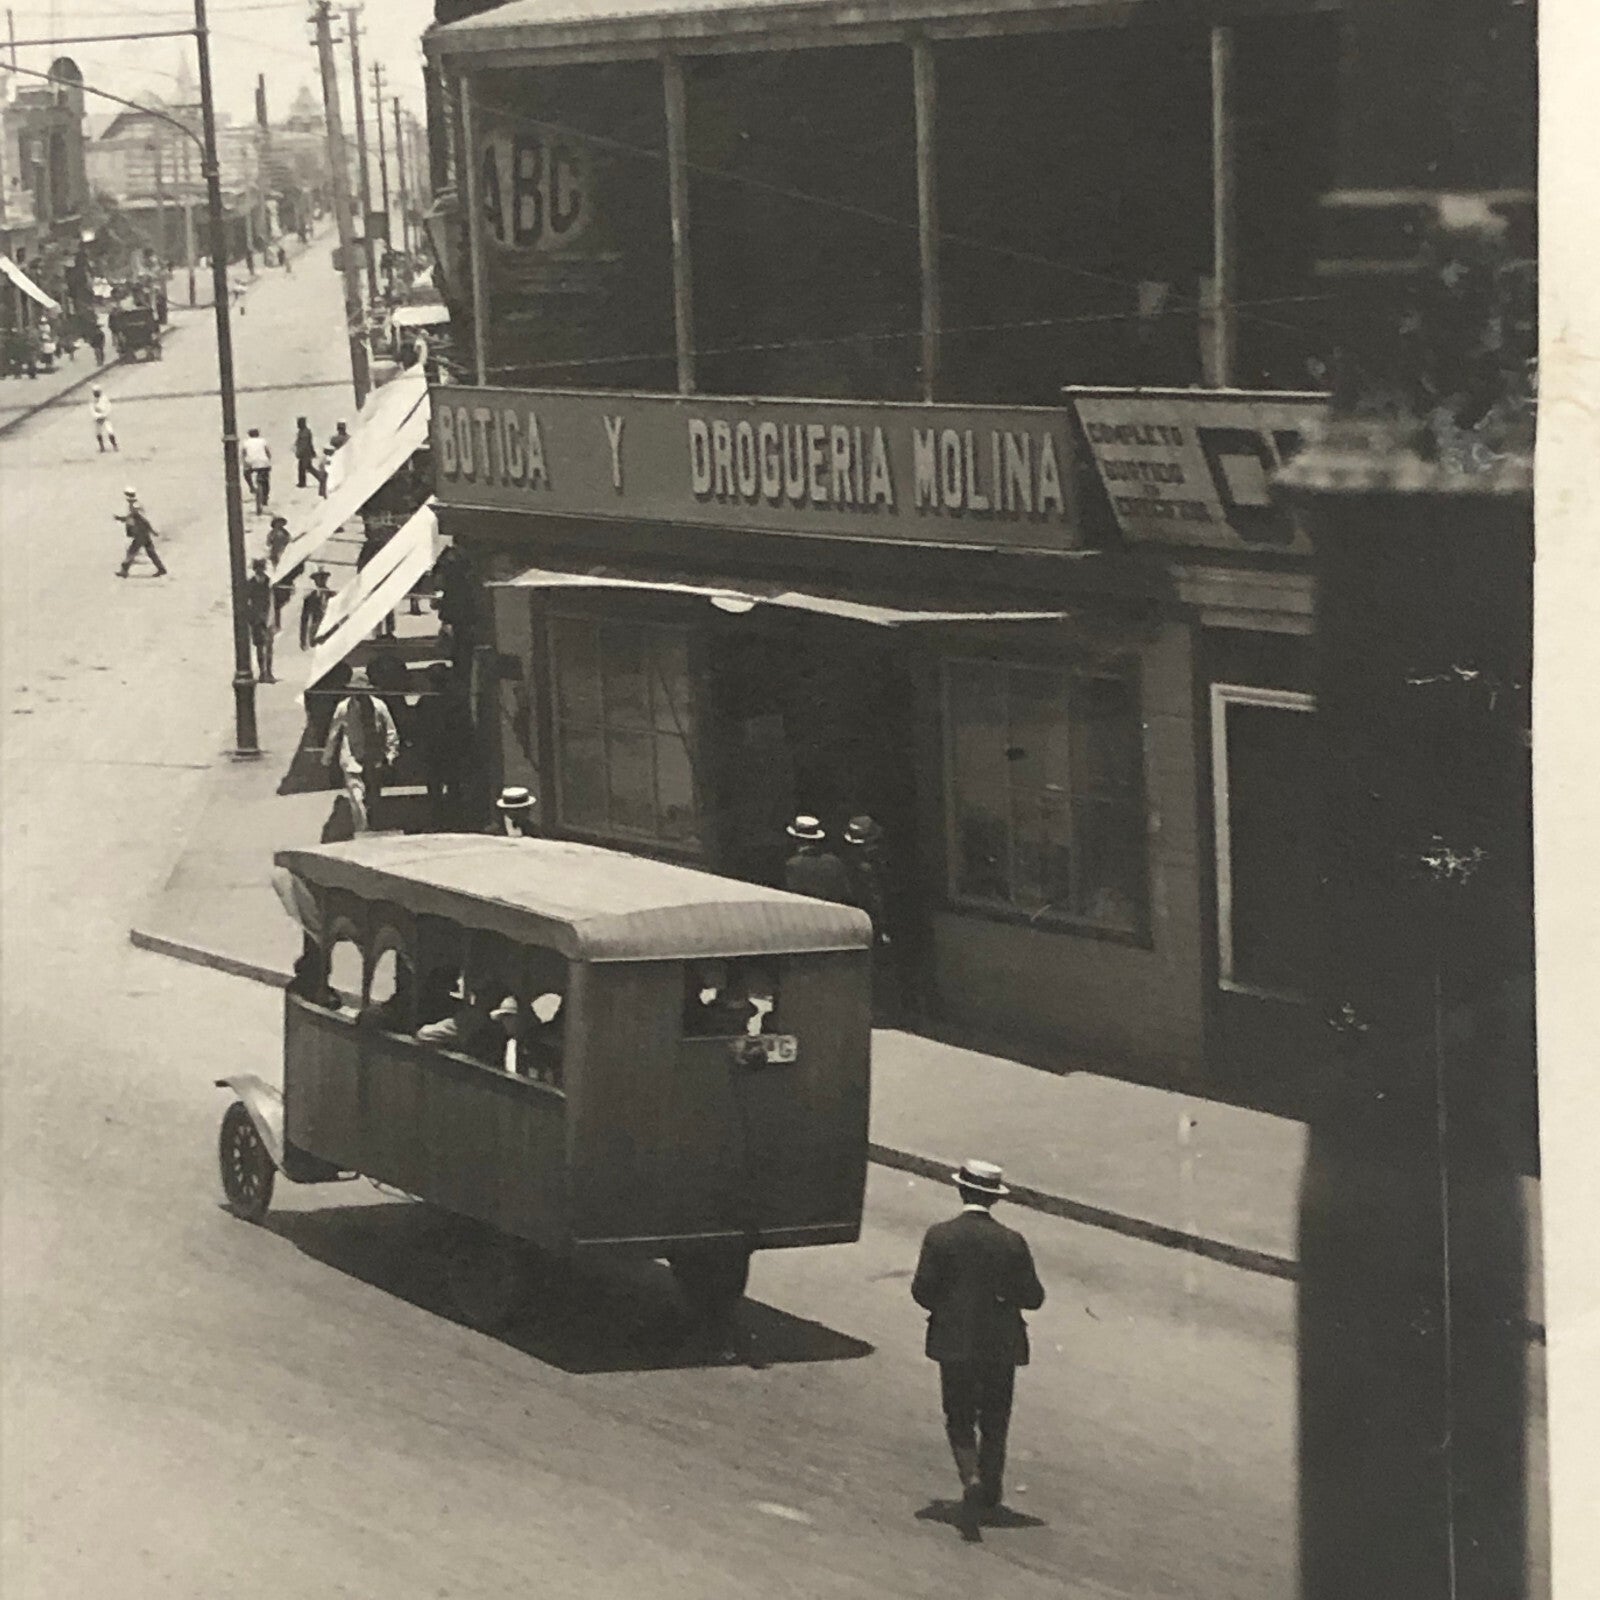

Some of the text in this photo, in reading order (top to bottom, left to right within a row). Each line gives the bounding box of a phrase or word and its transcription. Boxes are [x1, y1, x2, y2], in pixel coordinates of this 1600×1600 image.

[482, 135, 583, 247] ABC
[437, 405, 1064, 515] BOTICA Y DROGUERIA MOLINA
